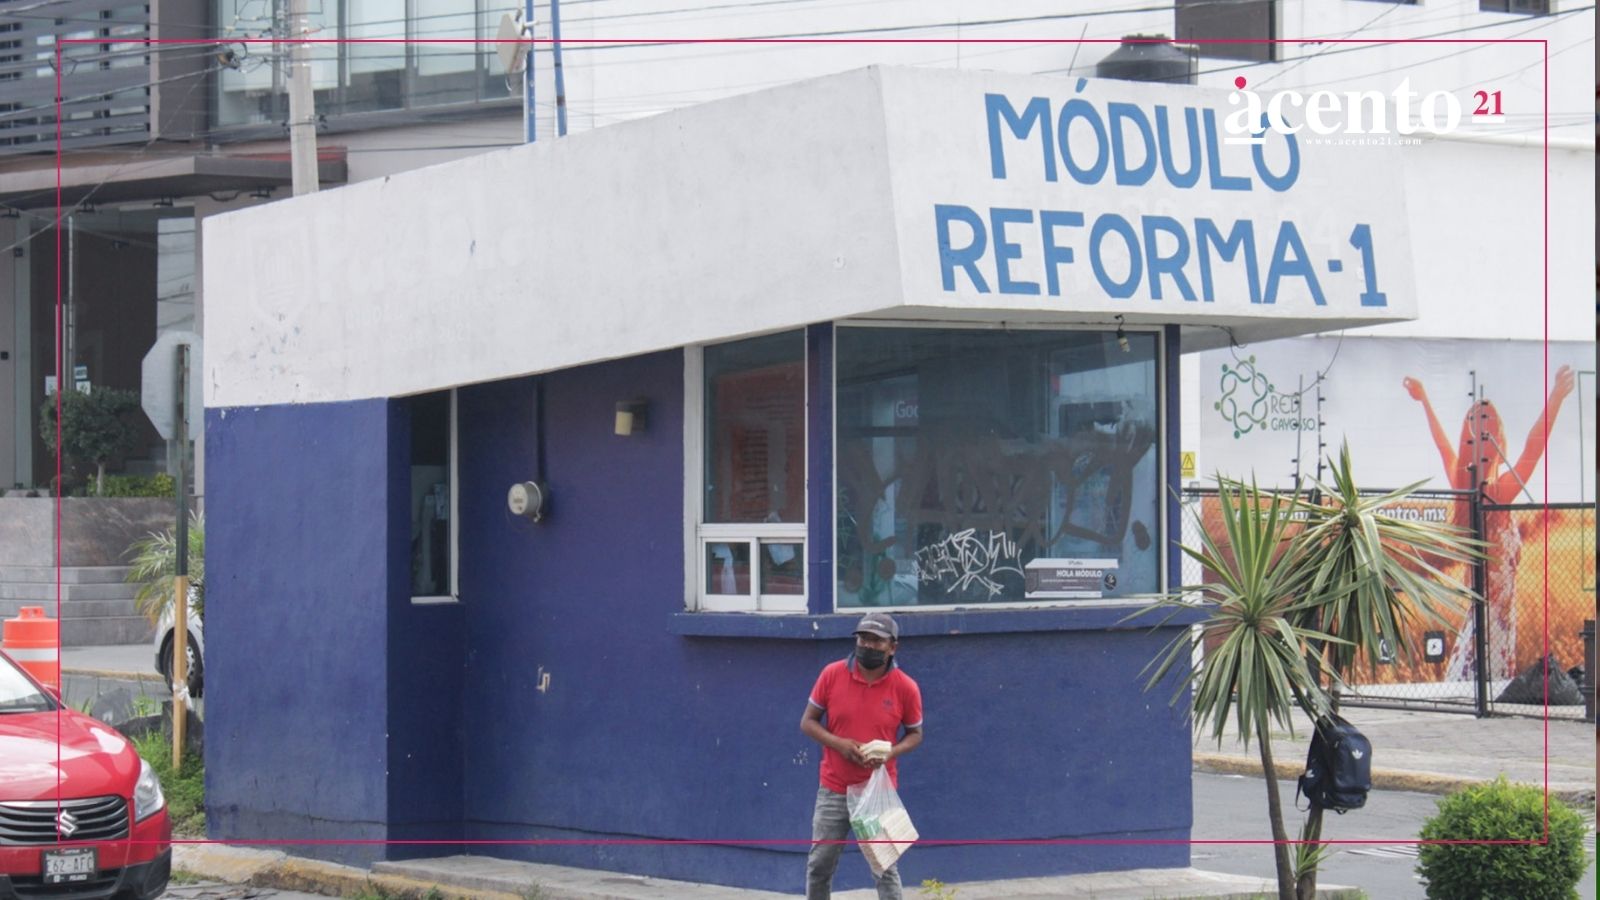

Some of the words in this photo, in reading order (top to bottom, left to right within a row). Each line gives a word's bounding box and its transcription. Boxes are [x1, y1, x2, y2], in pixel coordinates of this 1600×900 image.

[984, 78, 1301, 192] MÓDULO
[1271, 395, 1300, 414] RED
[1056, 569, 1074, 578] HOLA
[1074, 569, 1103, 578] MÓDULO
